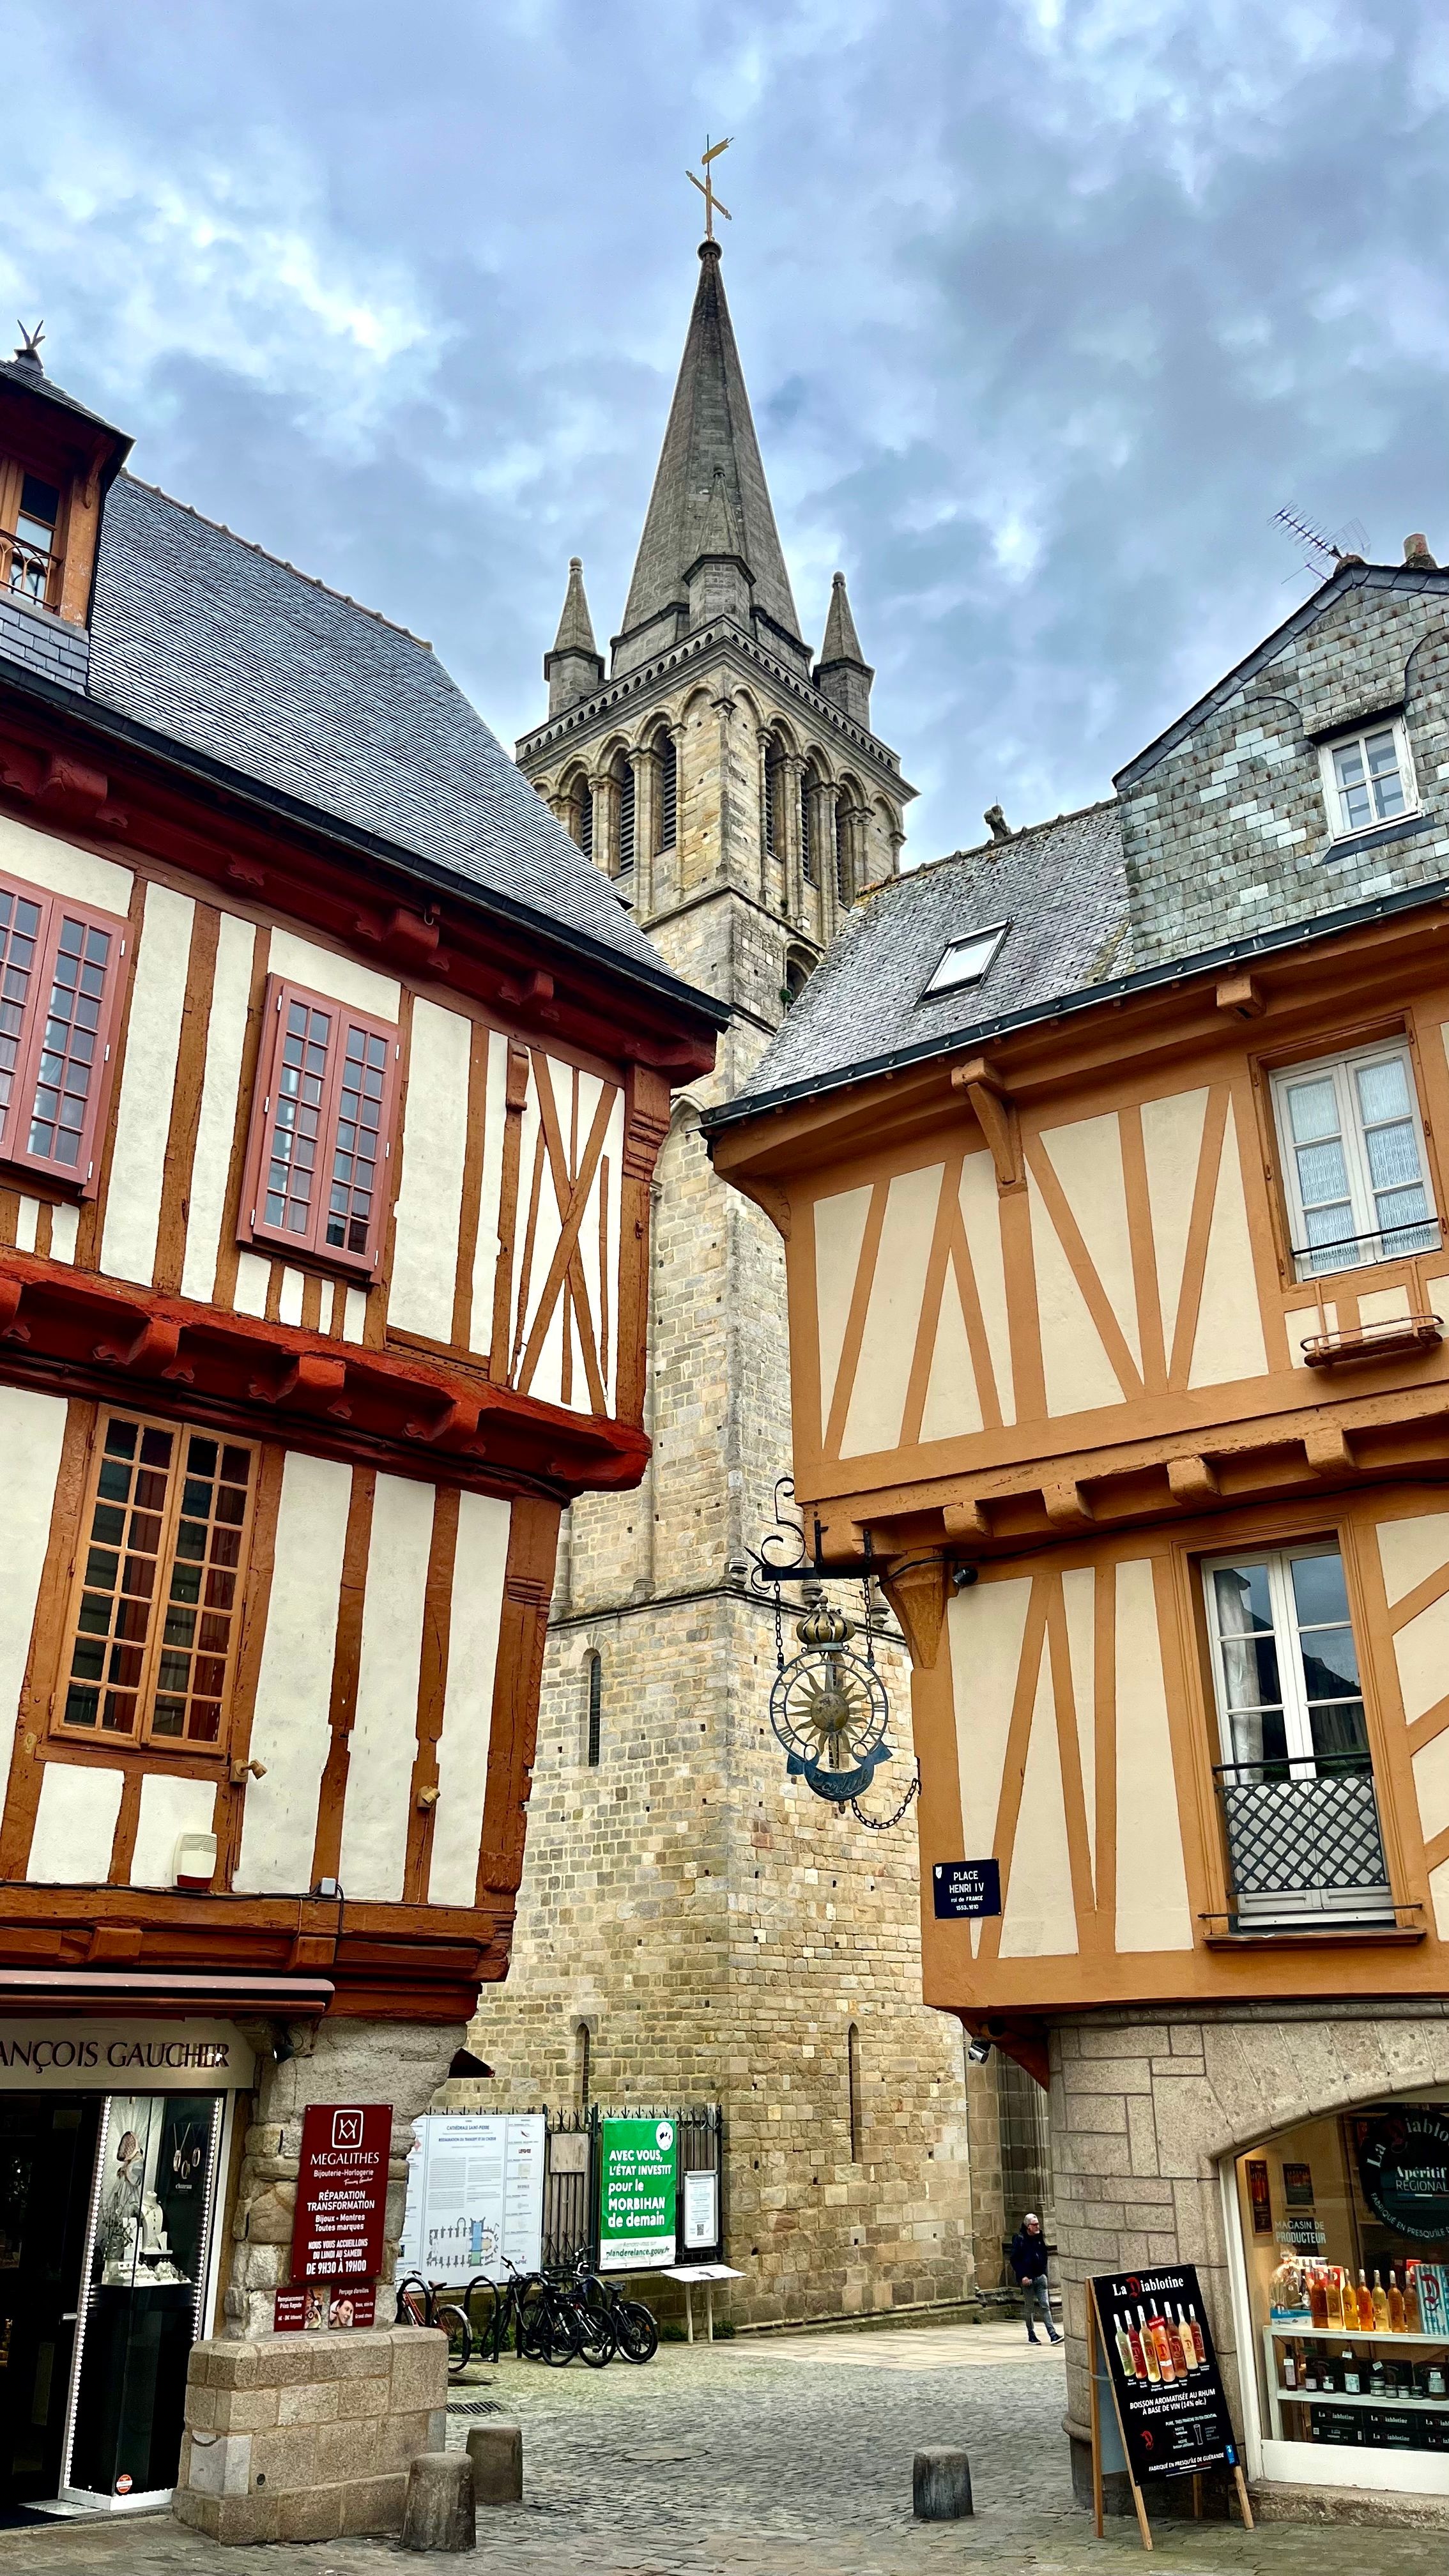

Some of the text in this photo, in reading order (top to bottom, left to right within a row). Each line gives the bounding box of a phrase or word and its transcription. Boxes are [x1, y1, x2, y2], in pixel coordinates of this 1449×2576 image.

[953, 1870, 979, 1881] PLACE
[949, 1882, 985, 1894] HENRI IV
[107, 2042, 229, 2067] GAUCHER
[310, 2152, 379, 2165] MEGALITHES
[609, 2150, 663, 2162] AVEC VOUS,
[1367, 2143, 1386, 2168] La
[609, 2163, 672, 2175] L'ÉTAT INVESTIT
[1397, 2166, 1447, 2181] Apéritif
[608, 2178, 644, 2196] pour le
[319, 2189, 366, 2201] RÉPARATION
[307, 2200, 375, 2211] TRANSFORMATION
[608, 2196, 665, 2211] MORBIHAN
[315, 2214, 335, 2224] Bijoux
[608, 2211, 665, 2227] de demain
[1275, 2220, 1324, 2230] MAGASIN DE
[337, 2223, 364, 2232] marques
[1396, 2221, 1406, 2231] EN
[1275, 2231, 1326, 2244] PRODUCTEUR
[308, 2239, 368, 2250] NOUS VOUS ACCUEILLONS
[312, 2251, 320, 2260] DU
[321, 2250, 335, 2258] LUNDI
[343, 2249, 362, 2258] SAMEDI
[606, 2246, 670, 2260] planderelance.gouv.fr
[306, 2258, 367, 2275] DE 9H30 À 19H00
[1112, 2276, 1184, 2303] La Diablotine
[1130, 2399, 1154, 2410] BOISSON
[1154, 2392, 1188, 2405] AROMATISÉE
[1198, 2388, 1216, 2397] RHUM
[1142, 2407, 1147, 2415] À
[1147, 2404, 1162, 2414] BASE
[1170, 2402, 1181, 2411] VIN
[1181, 2399, 1194, 2410] (14%
[1149, 2462, 1169, 2471] FABRIQUÉ
[1203, 2452, 1224, 2462] GUÉRANDE
